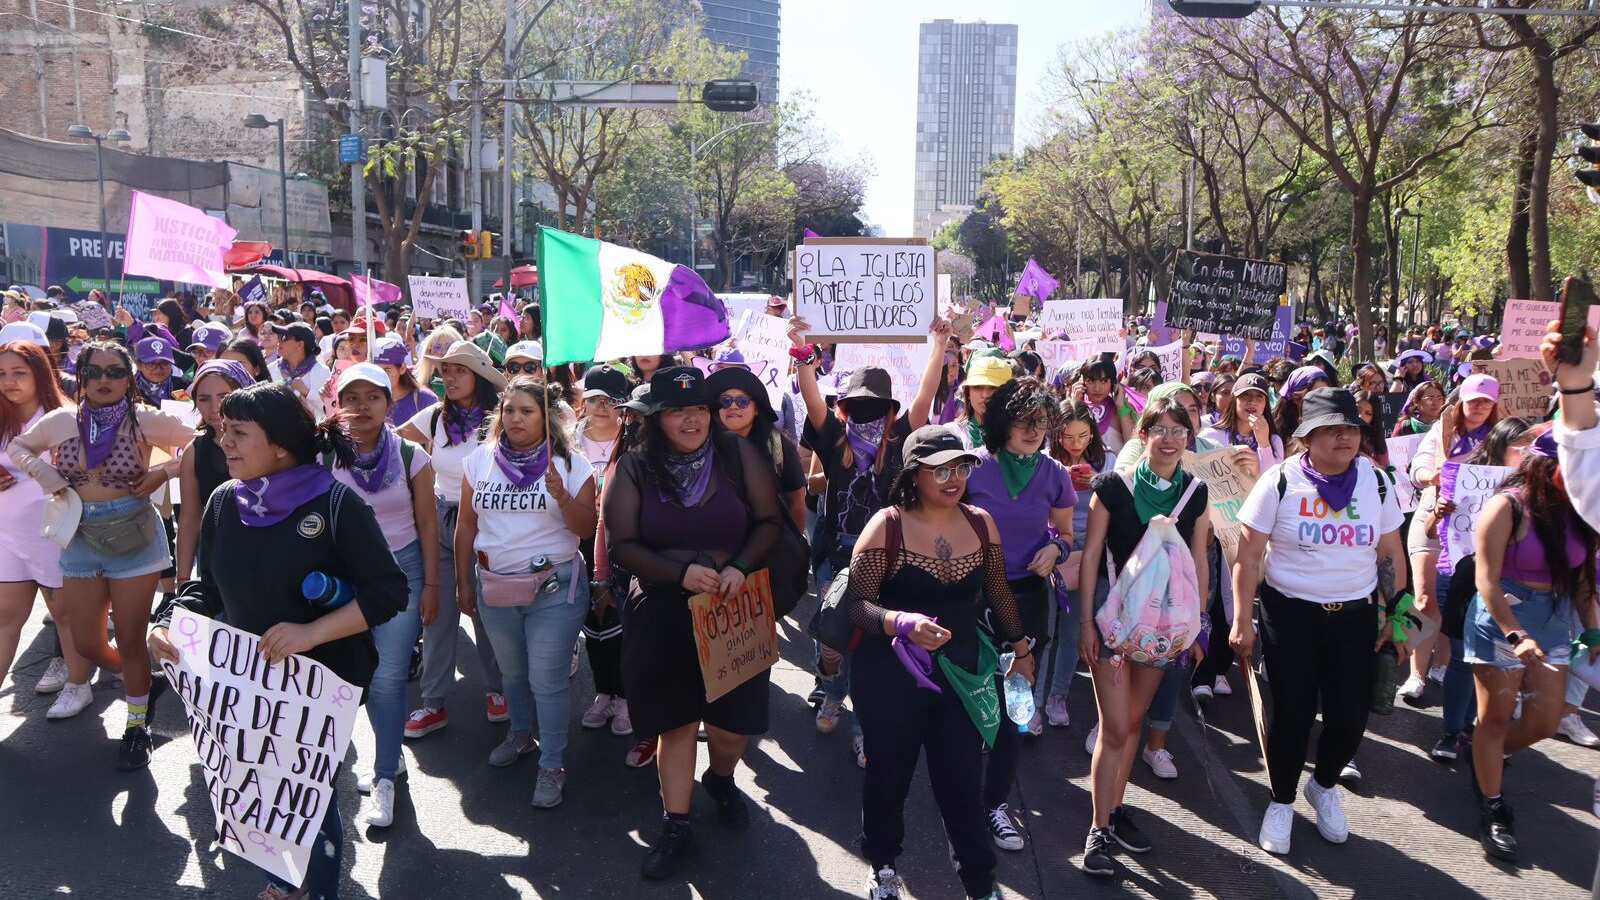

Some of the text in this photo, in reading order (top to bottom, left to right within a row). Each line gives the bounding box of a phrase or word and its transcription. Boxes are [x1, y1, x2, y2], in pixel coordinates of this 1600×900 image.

[69, 238, 125, 260] PREVE
[817, 249, 926, 281] LA IGLESIA
[799, 278, 865, 304] PROTEGE
[892, 281, 924, 304] LOS
[823, 304, 918, 331] VIOLADORES
[1225, 342, 1240, 352] NO
[475, 480, 489, 491] SOY
[490, 482, 502, 492] LA
[475, 492, 547, 511] PERFECTA
[1298, 520, 1375, 547] MORE!
[706, 586, 764, 640] FUEGO
[208, 628, 324, 700] QUIERO
[251, 695, 290, 737] DE
[296, 706, 337, 753] LA
[291, 747, 342, 790] SIN
[239, 768, 262, 798] A
[274, 777, 321, 819] NO
[264, 806, 311, 846] MI
